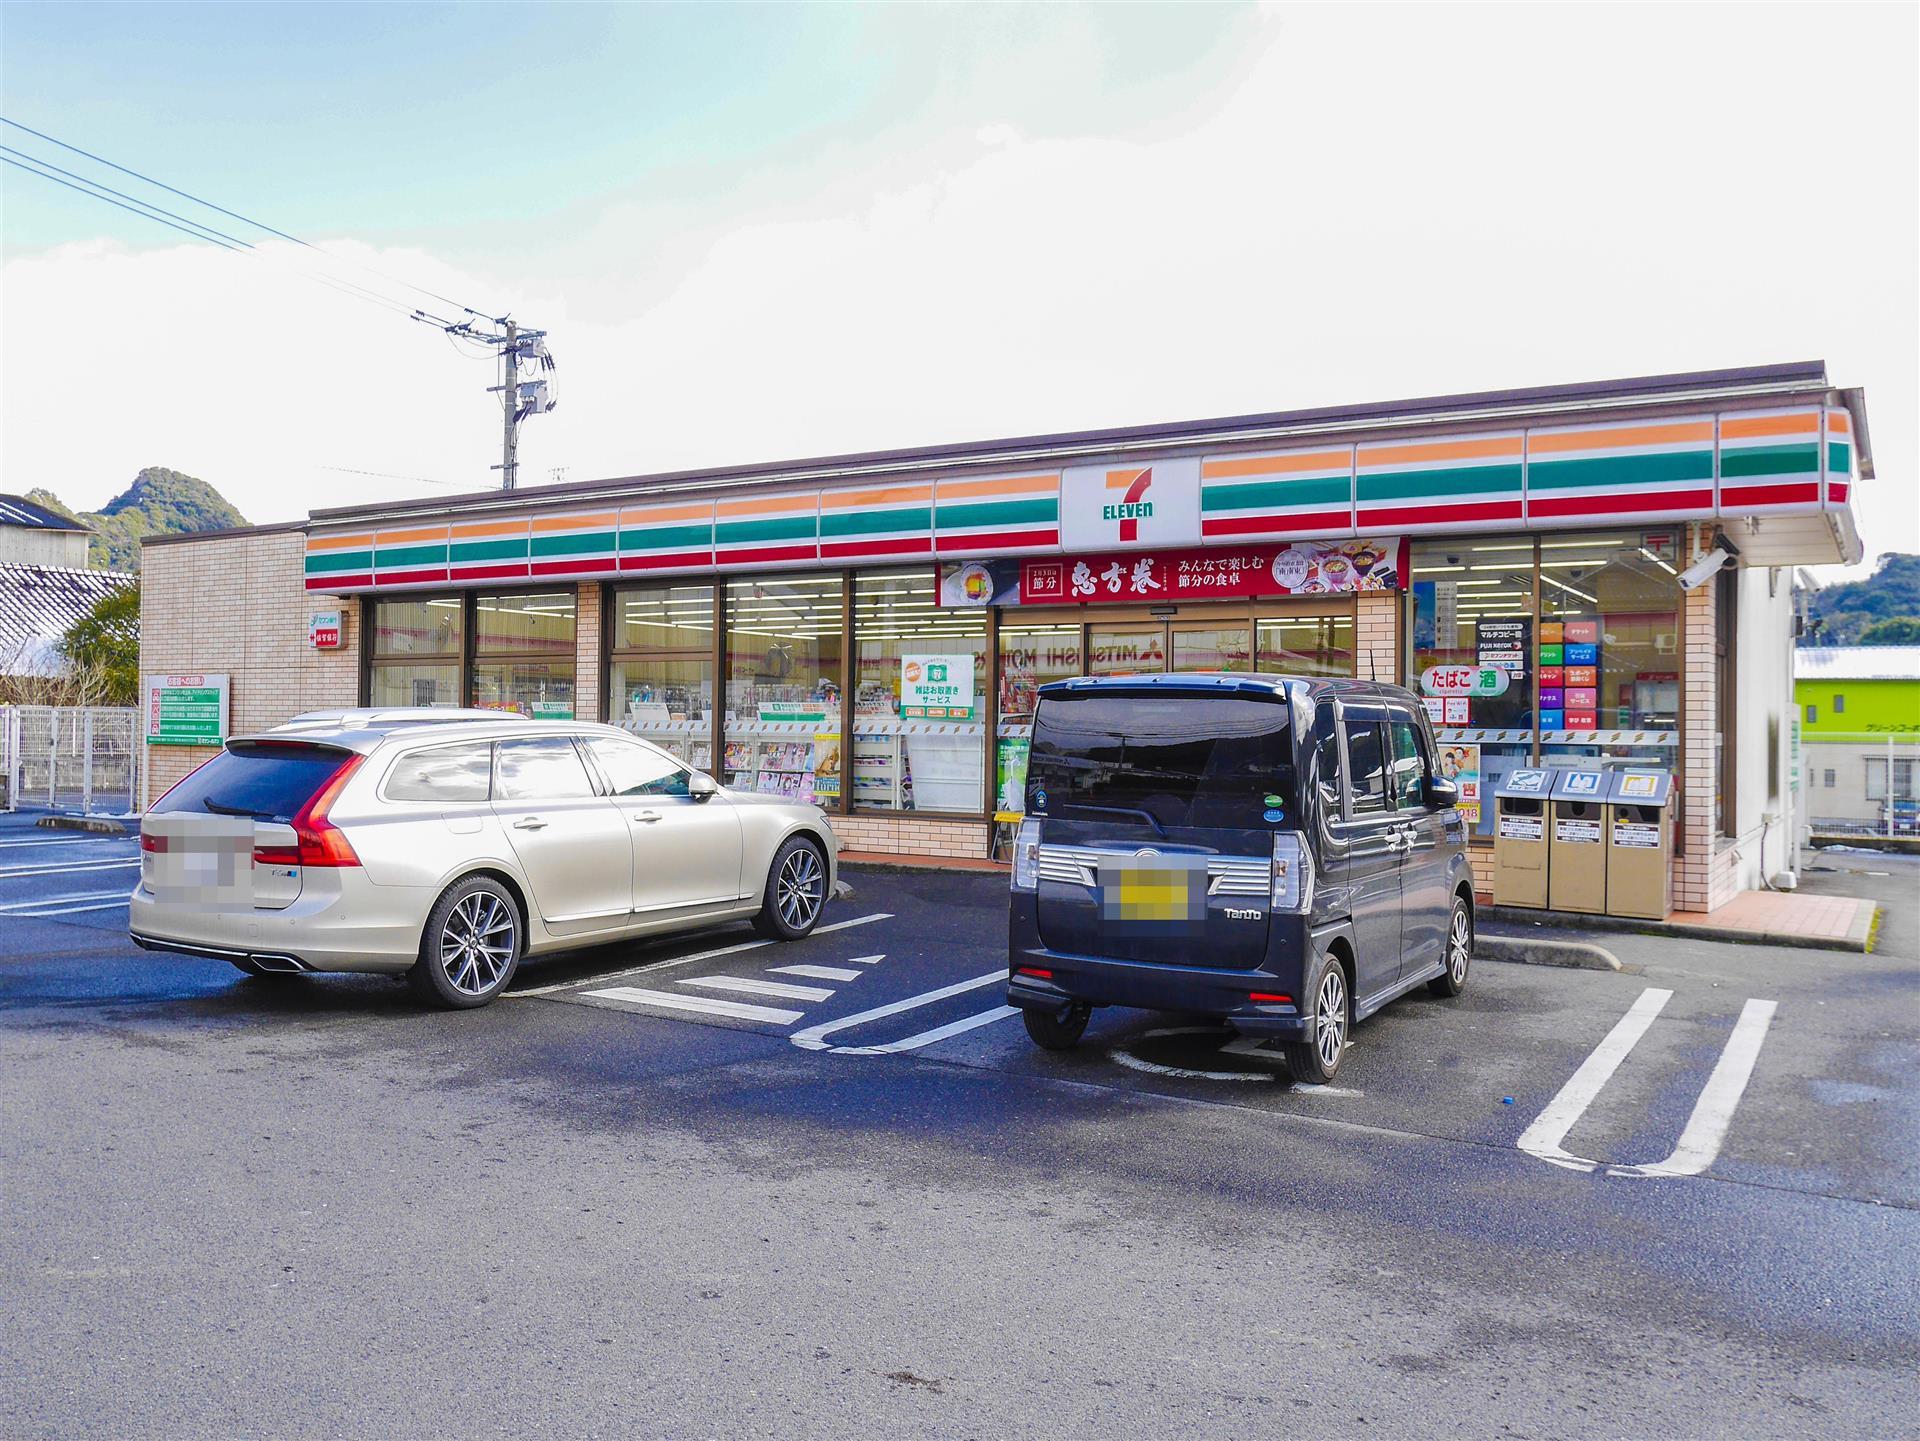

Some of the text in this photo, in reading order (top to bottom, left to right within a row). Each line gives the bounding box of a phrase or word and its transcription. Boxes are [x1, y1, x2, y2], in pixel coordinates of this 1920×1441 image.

[1178, 555, 1264, 572] みんなで楽しむ
[1033, 576, 1057, 590] 節分
[1178, 572, 1241, 588] 節分の食卓
[1432, 670, 1497, 688] たばこ 酒
[922, 696, 951, 704] サービス
